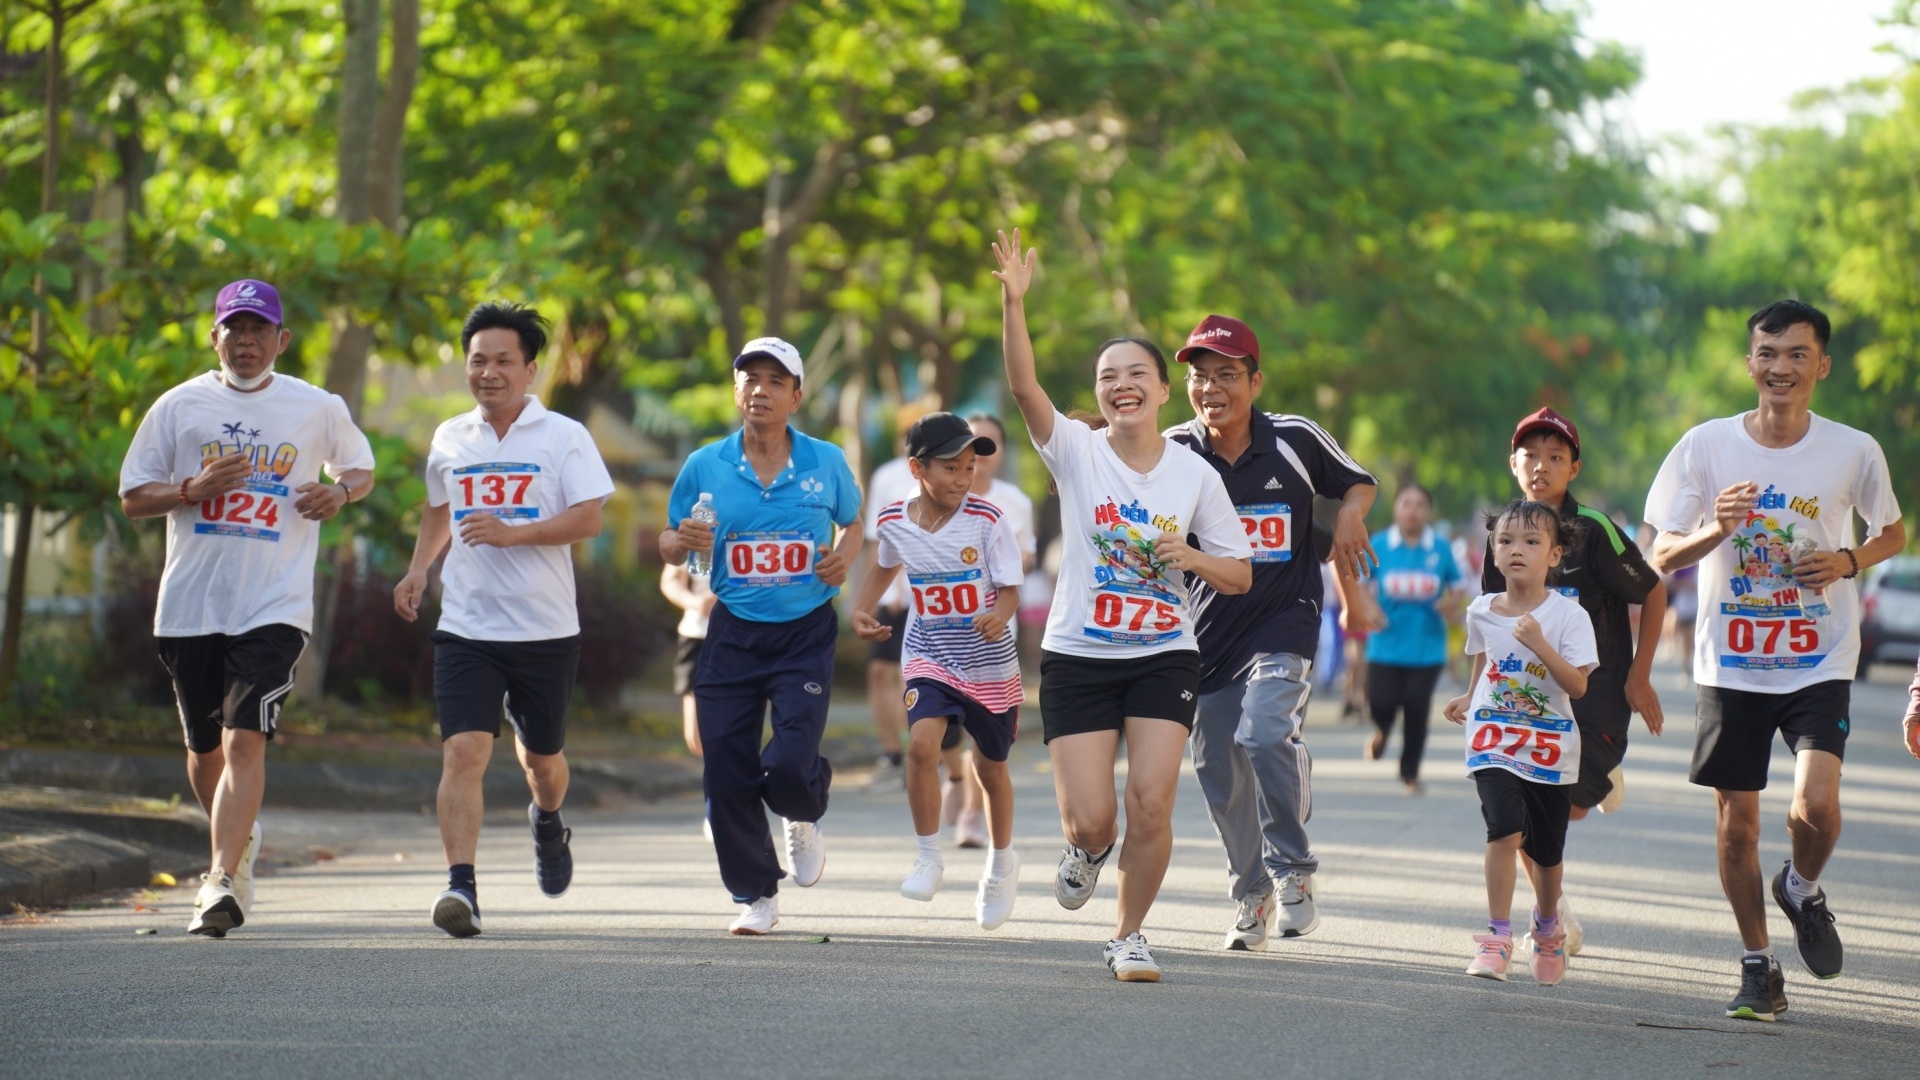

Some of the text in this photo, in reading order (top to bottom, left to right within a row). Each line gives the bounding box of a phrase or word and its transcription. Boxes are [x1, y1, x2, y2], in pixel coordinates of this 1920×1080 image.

[458, 474, 533, 507] 137
[201, 492, 278, 528] 024
[1094, 495, 1121, 526] HÈ
[1119, 499, 1149, 525] ĐẾN
[1239, 516, 1285, 549] 29
[731, 542, 809, 575] 030
[1094, 564, 1118, 584] ĐI
[1729, 575, 1753, 598] ĐI
[1093, 593, 1181, 632] 075
[1728, 617, 1819, 655] 075
[1498, 652, 1523, 673] ĐẾN
[1471, 723, 1562, 767] 075
